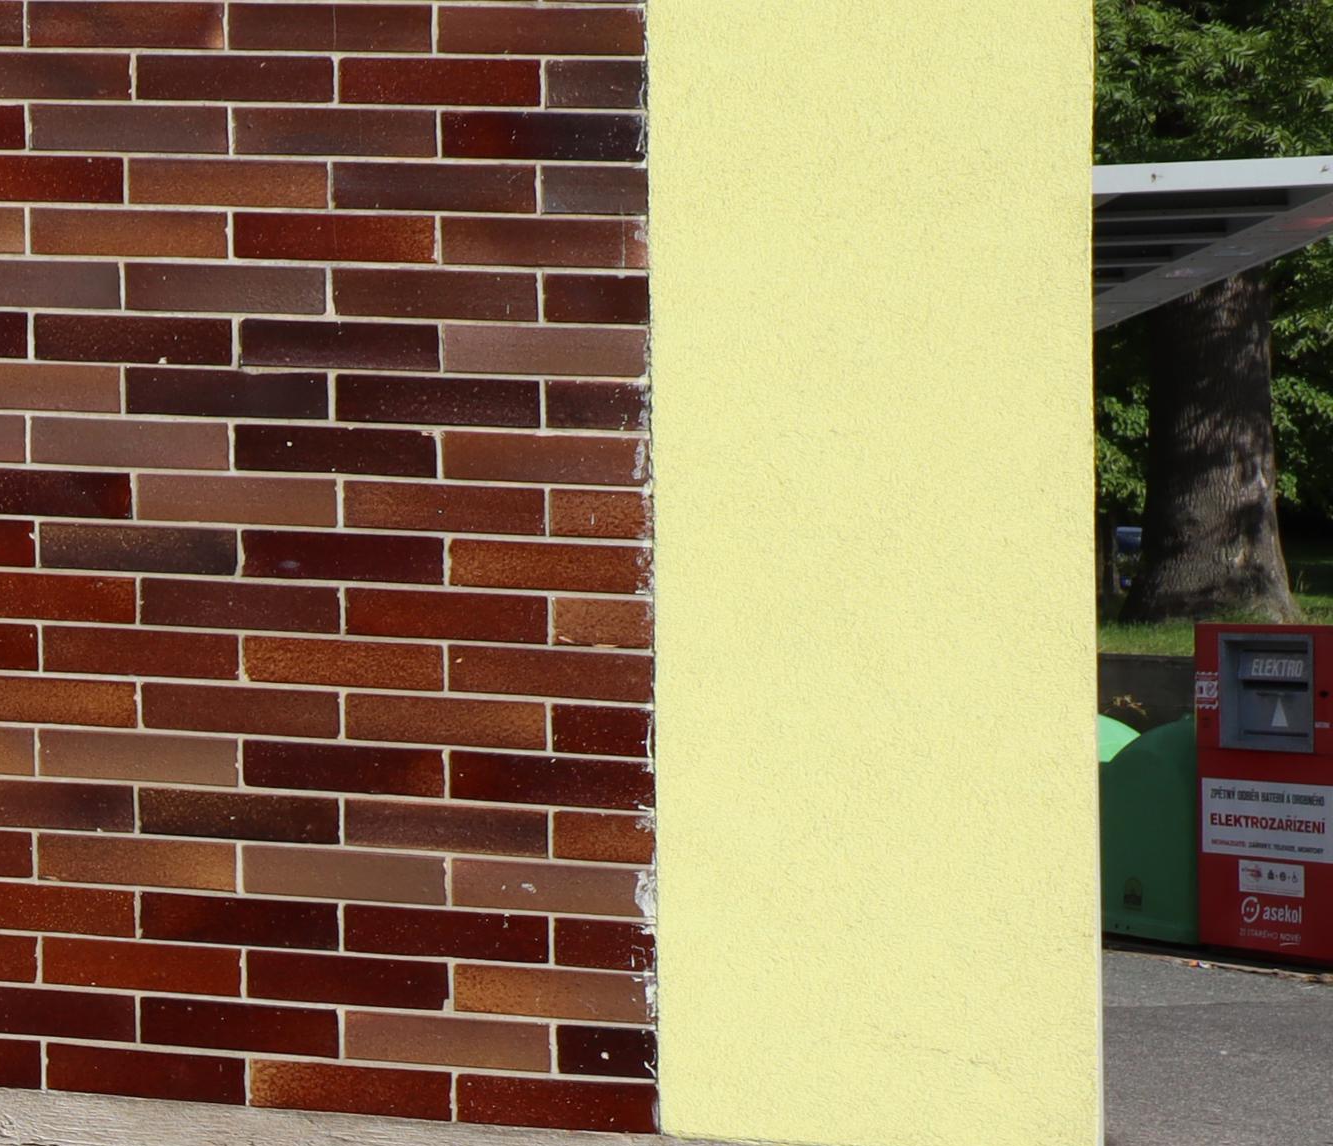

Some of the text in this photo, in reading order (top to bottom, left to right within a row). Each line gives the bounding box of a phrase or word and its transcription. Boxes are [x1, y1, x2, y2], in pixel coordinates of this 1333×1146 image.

[1251, 658, 1304, 677] ELEKTRO
[1210, 812, 1325, 834] ELEKTROZAŘÍZENÍ
[1262, 905, 1302, 924] asekol
